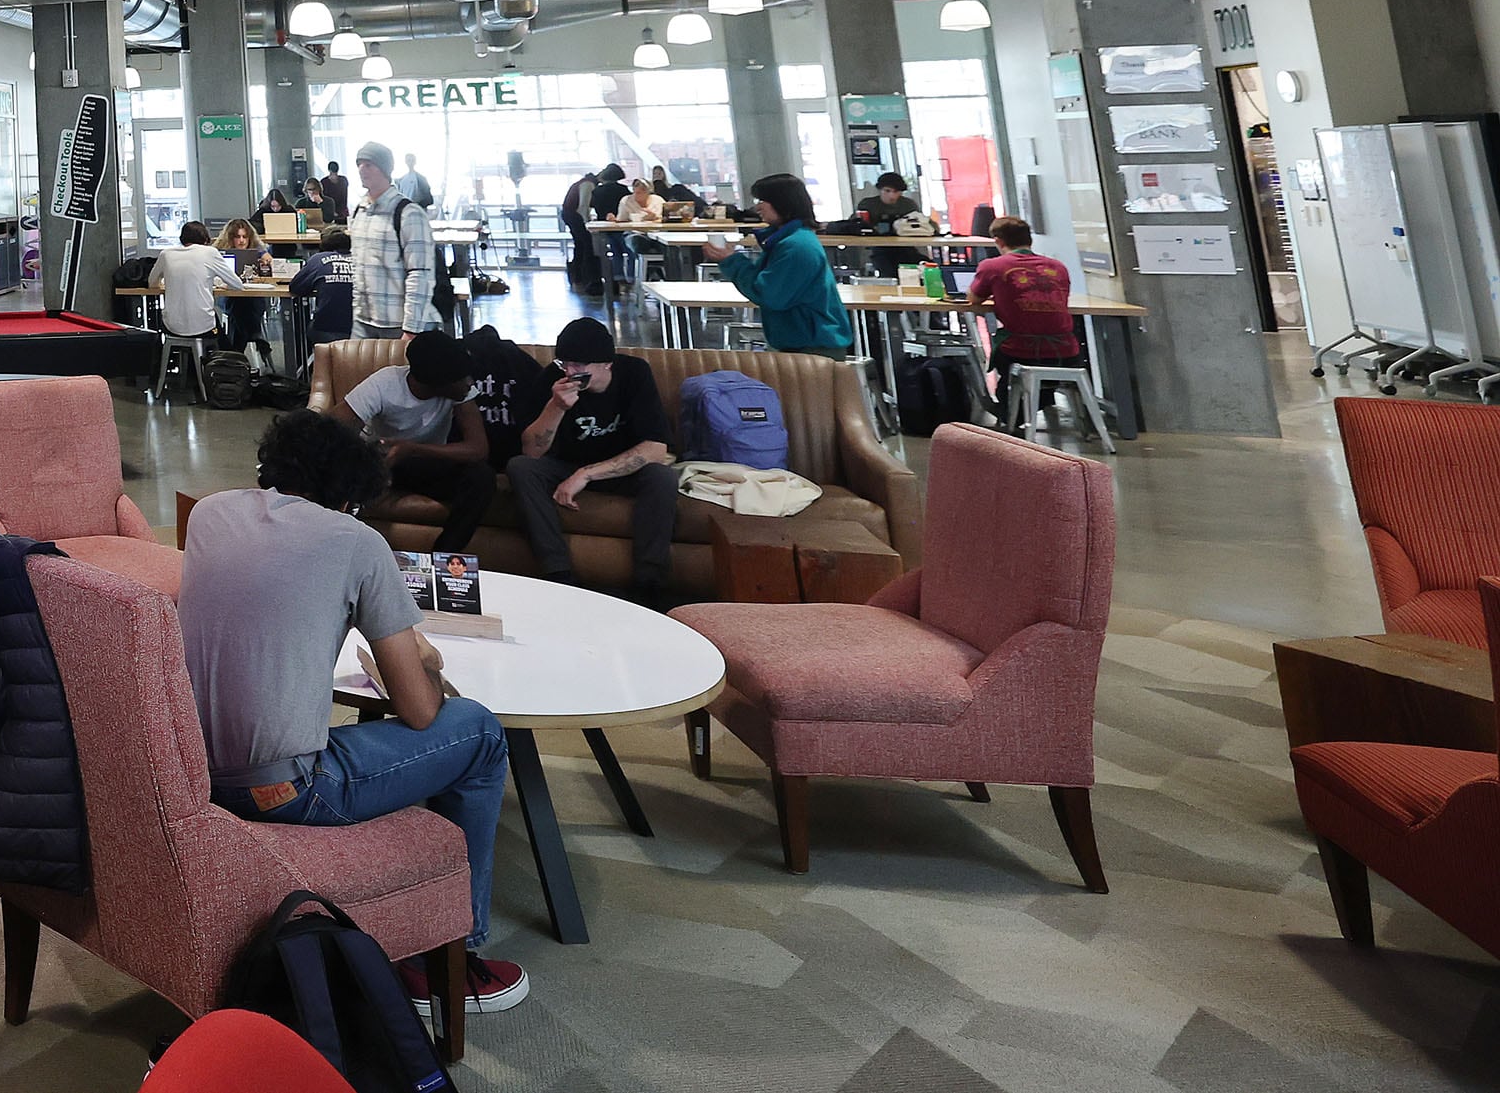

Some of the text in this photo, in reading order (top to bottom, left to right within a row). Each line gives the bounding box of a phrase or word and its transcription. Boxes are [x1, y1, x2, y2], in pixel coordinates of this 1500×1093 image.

[361, 82, 518, 109] CREATE
[1139, 129, 1181, 139] BANK
[54, 132, 73, 213] Checkout Tools
[574, 413, 623, 441] Fend
